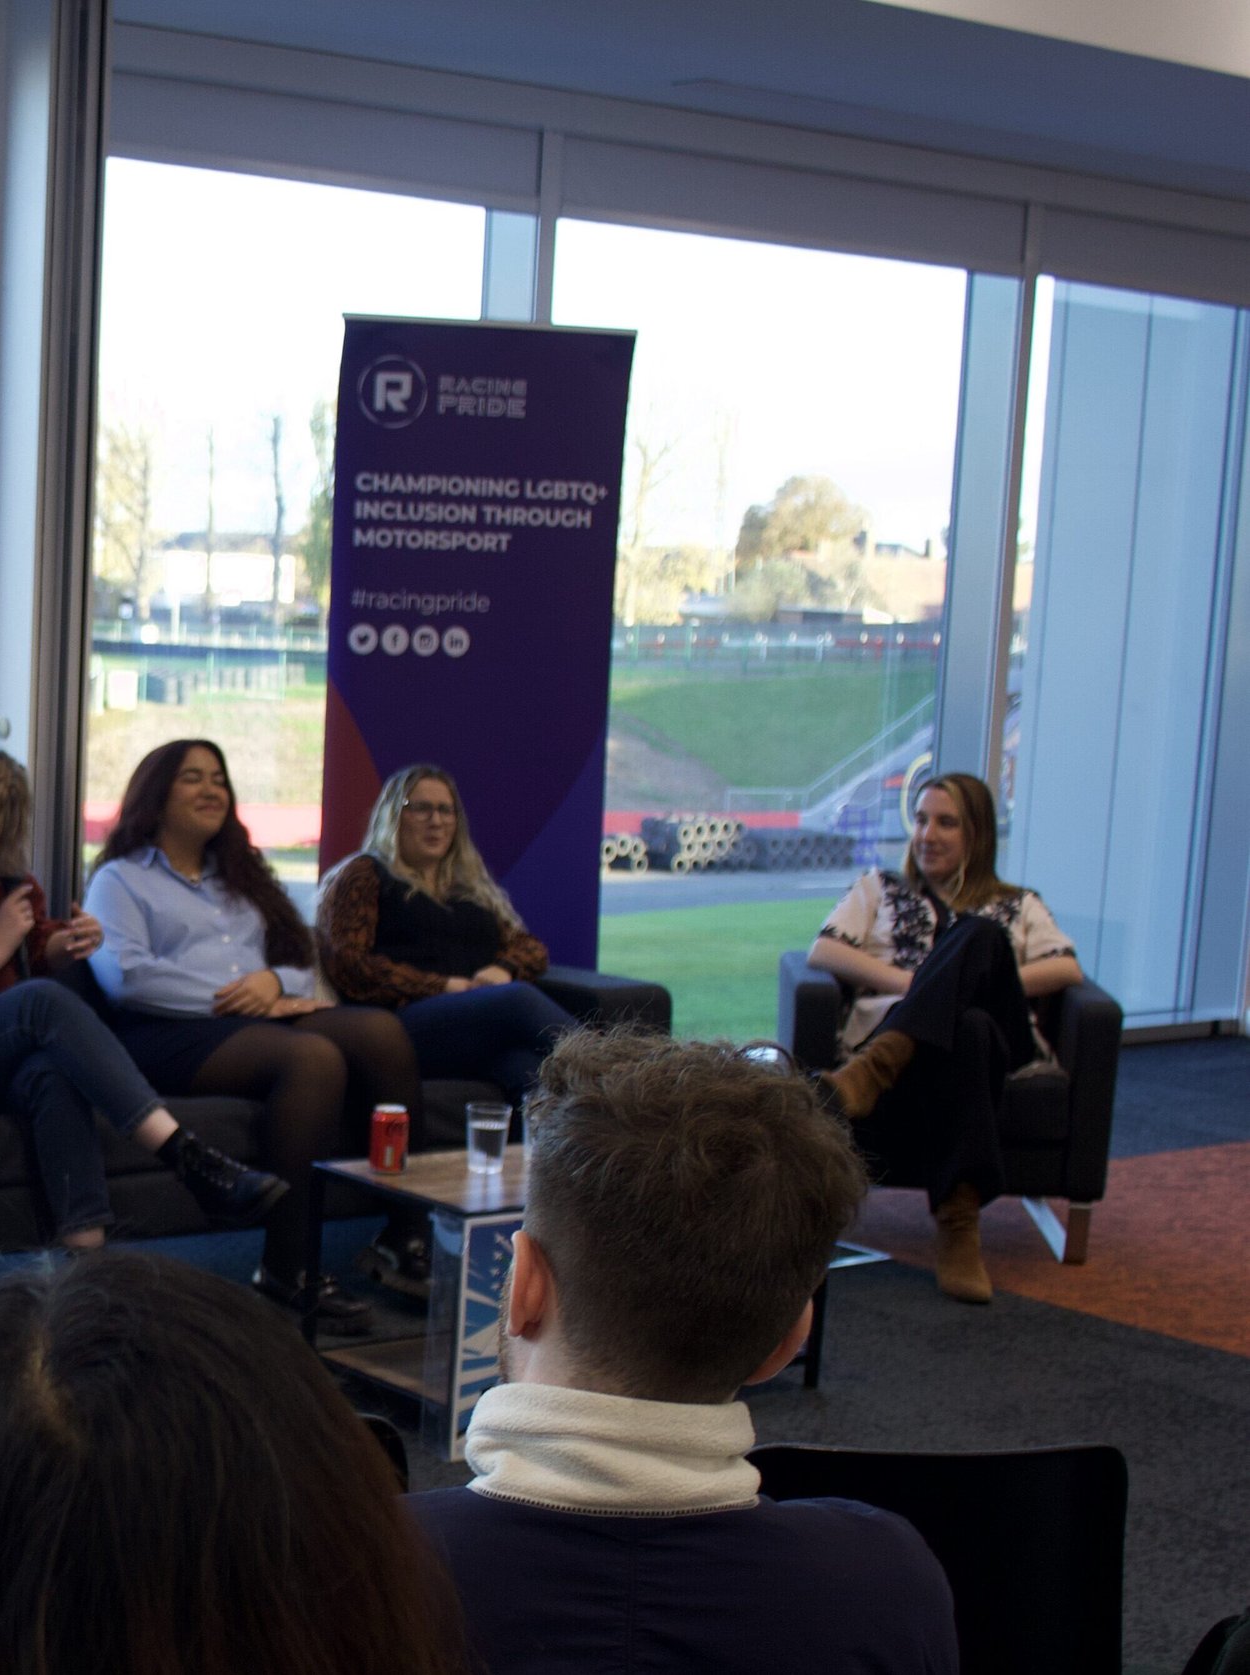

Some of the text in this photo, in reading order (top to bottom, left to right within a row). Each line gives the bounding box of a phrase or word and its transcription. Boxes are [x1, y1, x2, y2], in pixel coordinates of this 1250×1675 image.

[374, 371, 413, 412] R
[438, 376, 527, 396] RACING
[438, 394, 526, 419] PRIDE
[355, 472, 608, 504] CHAMPIONING LGBTQ+
[355, 501, 592, 529] INCLUSION THROUGH
[354, 528, 512, 552] MOTORSPORT
[351, 588, 491, 615] #racingpride
